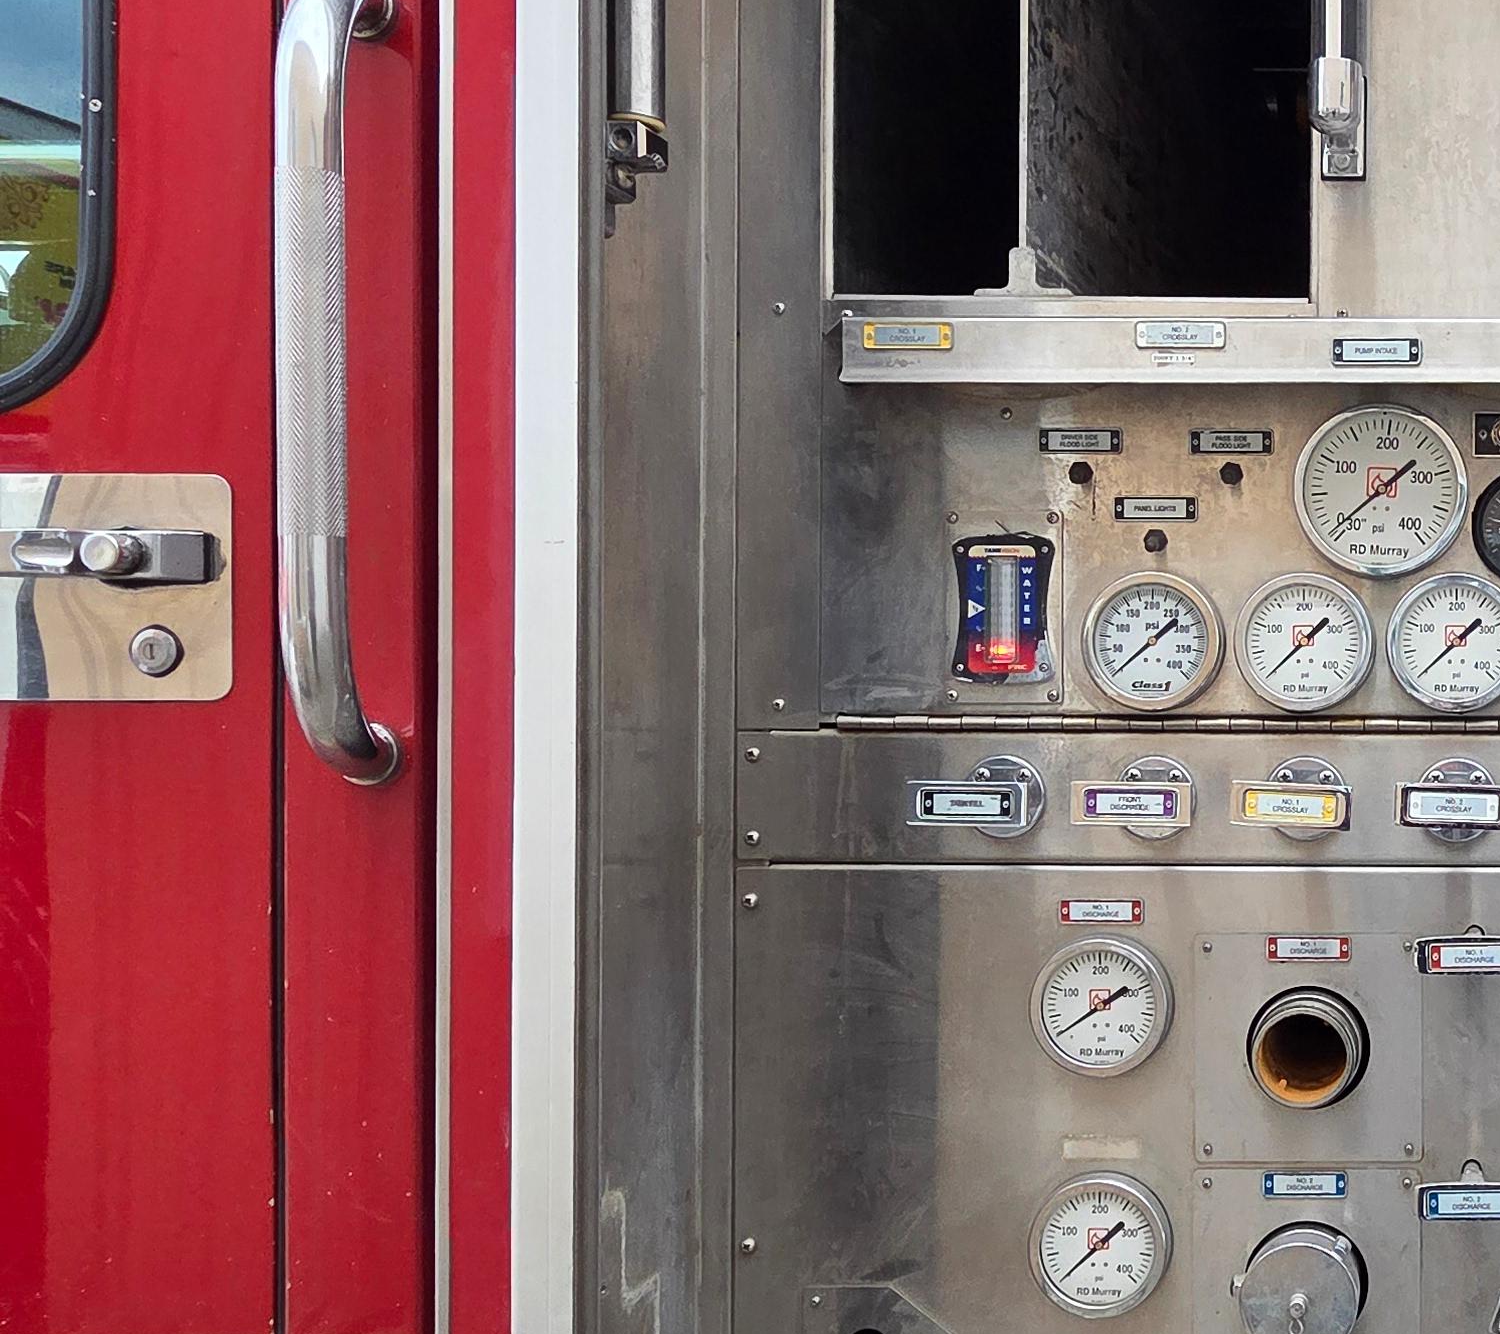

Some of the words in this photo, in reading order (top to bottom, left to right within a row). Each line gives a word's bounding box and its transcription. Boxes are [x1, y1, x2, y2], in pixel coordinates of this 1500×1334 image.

[1162, 333, 1198, 341] CROSSLAY
[1354, 347, 1374, 355] PUMP
[1375, 347, 1398, 355] INTAKE
[1376, 437, 1399, 450] 200
[1335, 461, 1357, 474] 100
[1410, 471, 1433, 484] 300
[1399, 517, 1421, 530] 400
[1372, 523, 1385, 534] psi
[1350, 544, 1366, 555] RD
[1370, 545, 1409, 558] Murray
[1021, 567, 1033, 625] WATER
[1144, 601, 1160, 610] 200
[1296, 602, 1313, 612] 200
[1448, 602, 1465, 612] 200
[1126, 609, 1141, 618] 150
[1163, 608, 1179, 617] 250
[1115, 624, 1130, 633] 100
[1145, 621, 1160, 631] psi
[1267, 625, 1282, 633] 100
[1326, 625, 1342, 634] 300
[1419, 624, 1435, 633] 100
[1479, 625, 1495, 635] 300
[1113, 645, 1124, 653] 50
[1175, 645, 1192, 653] 350
[1166, 660, 1183, 669] 400
[1322, 661, 1339, 670] 400
[1474, 661, 1490, 670] 400
[1283, 684, 1296, 693] RD
[1298, 684, 1328, 694] Murray
[1434, 684, 1448, 693] RD
[1449, 684, 1479, 694] Murray
[1272, 805, 1309, 814] CROSSLAY
[1435, 805, 1472, 813] CROSSLAY
[1454, 956, 1495, 964] DISCHARGE
[1092, 966, 1109, 975] 200
[1063, 988, 1079, 997] 100
[1118, 1024, 1135, 1034] 400
[1080, 1048, 1093, 1056] RD
[1095, 1048, 1124, 1057] Murray
[1092, 1205, 1109, 1214] 200
[1452, 1202, 1491, 1211] DISCHARGE
[1062, 1227, 1077, 1236] 100
[1121, 1228, 1138, 1238] 300
[1116, 1264, 1133, 1274] 400
[1076, 1288, 1089, 1296] RD
[1092, 1288, 1122, 1297] Murray
